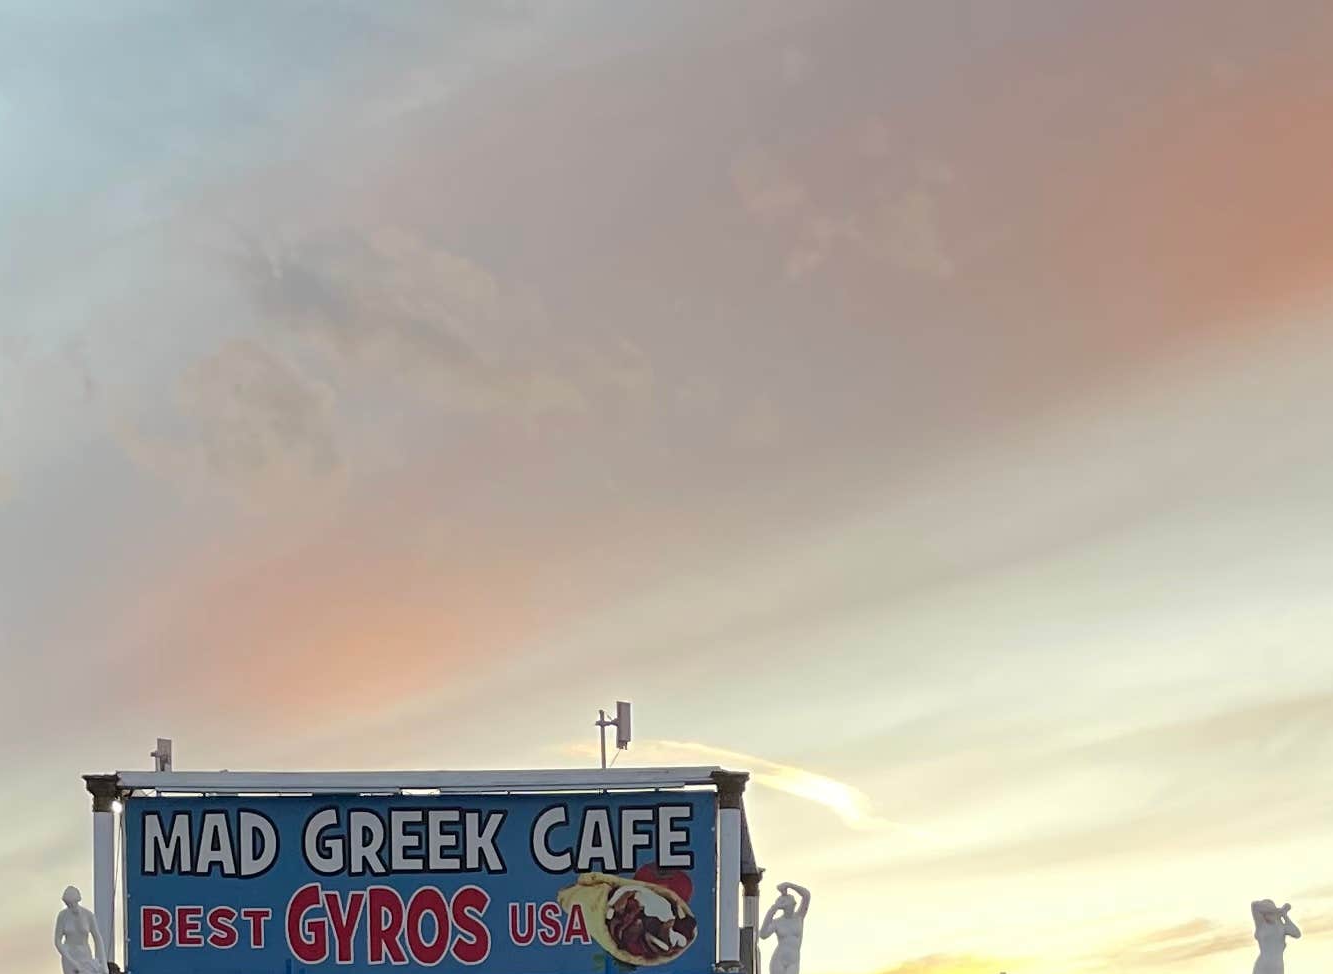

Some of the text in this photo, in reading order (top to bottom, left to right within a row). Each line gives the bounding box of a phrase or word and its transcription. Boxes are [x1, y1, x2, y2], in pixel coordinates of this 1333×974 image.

[142, 804, 694, 877] MAD GREEK CAFE
[141, 883, 591, 967] BEST GYROS USA
